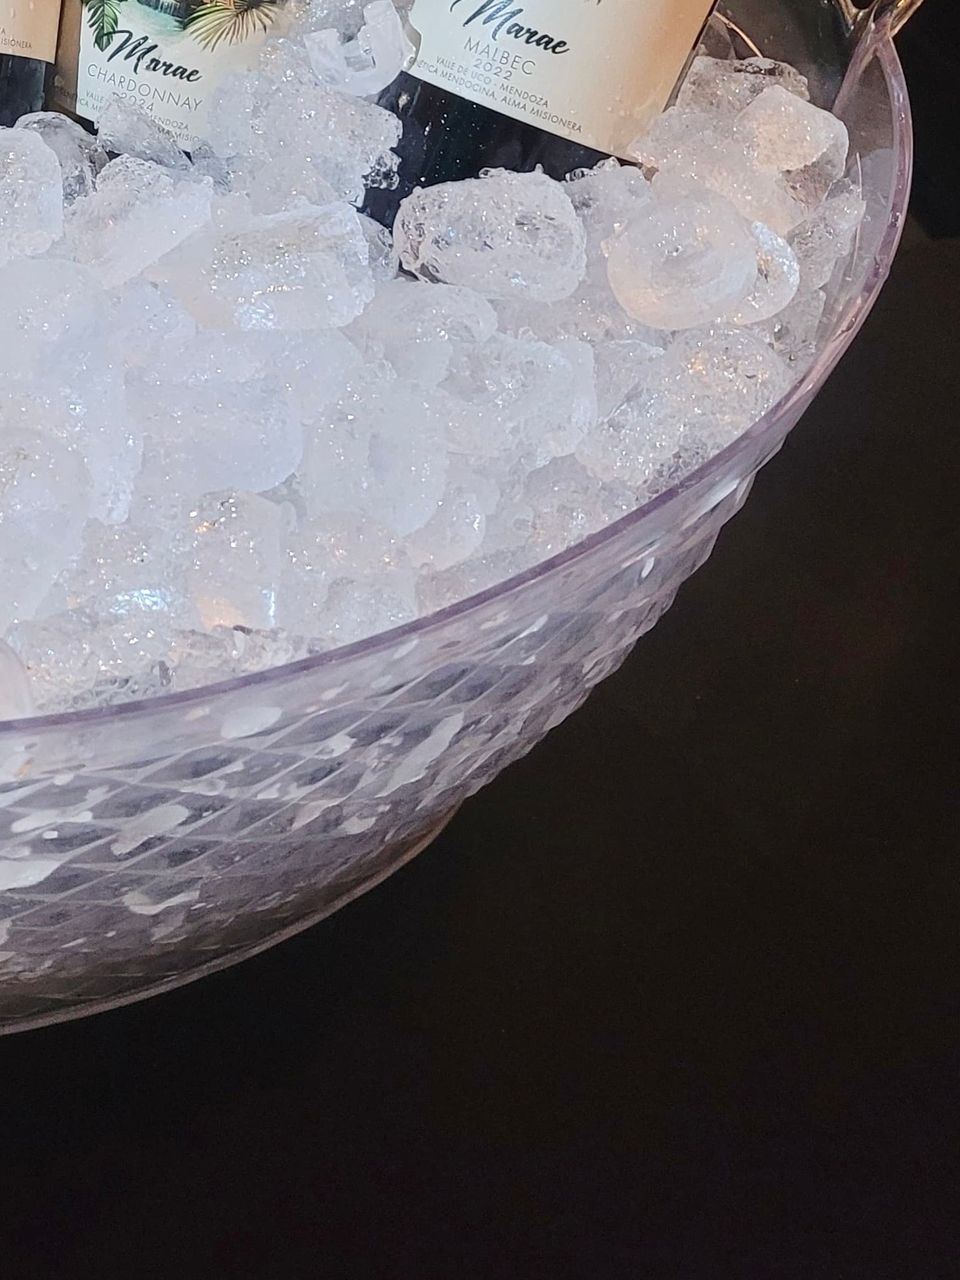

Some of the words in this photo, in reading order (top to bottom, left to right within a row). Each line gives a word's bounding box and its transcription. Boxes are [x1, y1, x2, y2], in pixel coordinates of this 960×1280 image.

[100, 30, 203, 83] Marae
[464, 36, 537, 76] MALBEC
[473, 58, 513, 81] 2022
[87, 63, 203, 112] CHARDONNAY
[436, 55, 456, 71] VALLE
[457, 64, 469, 75] DE
[470, 70, 492, 84] UCO
[499, 83, 549, 109] MENDOZA
[150, 114, 189, 131] ENDOZA
[501, 95, 527, 112] ALMA
[529, 106, 583, 133] MISIONERA
